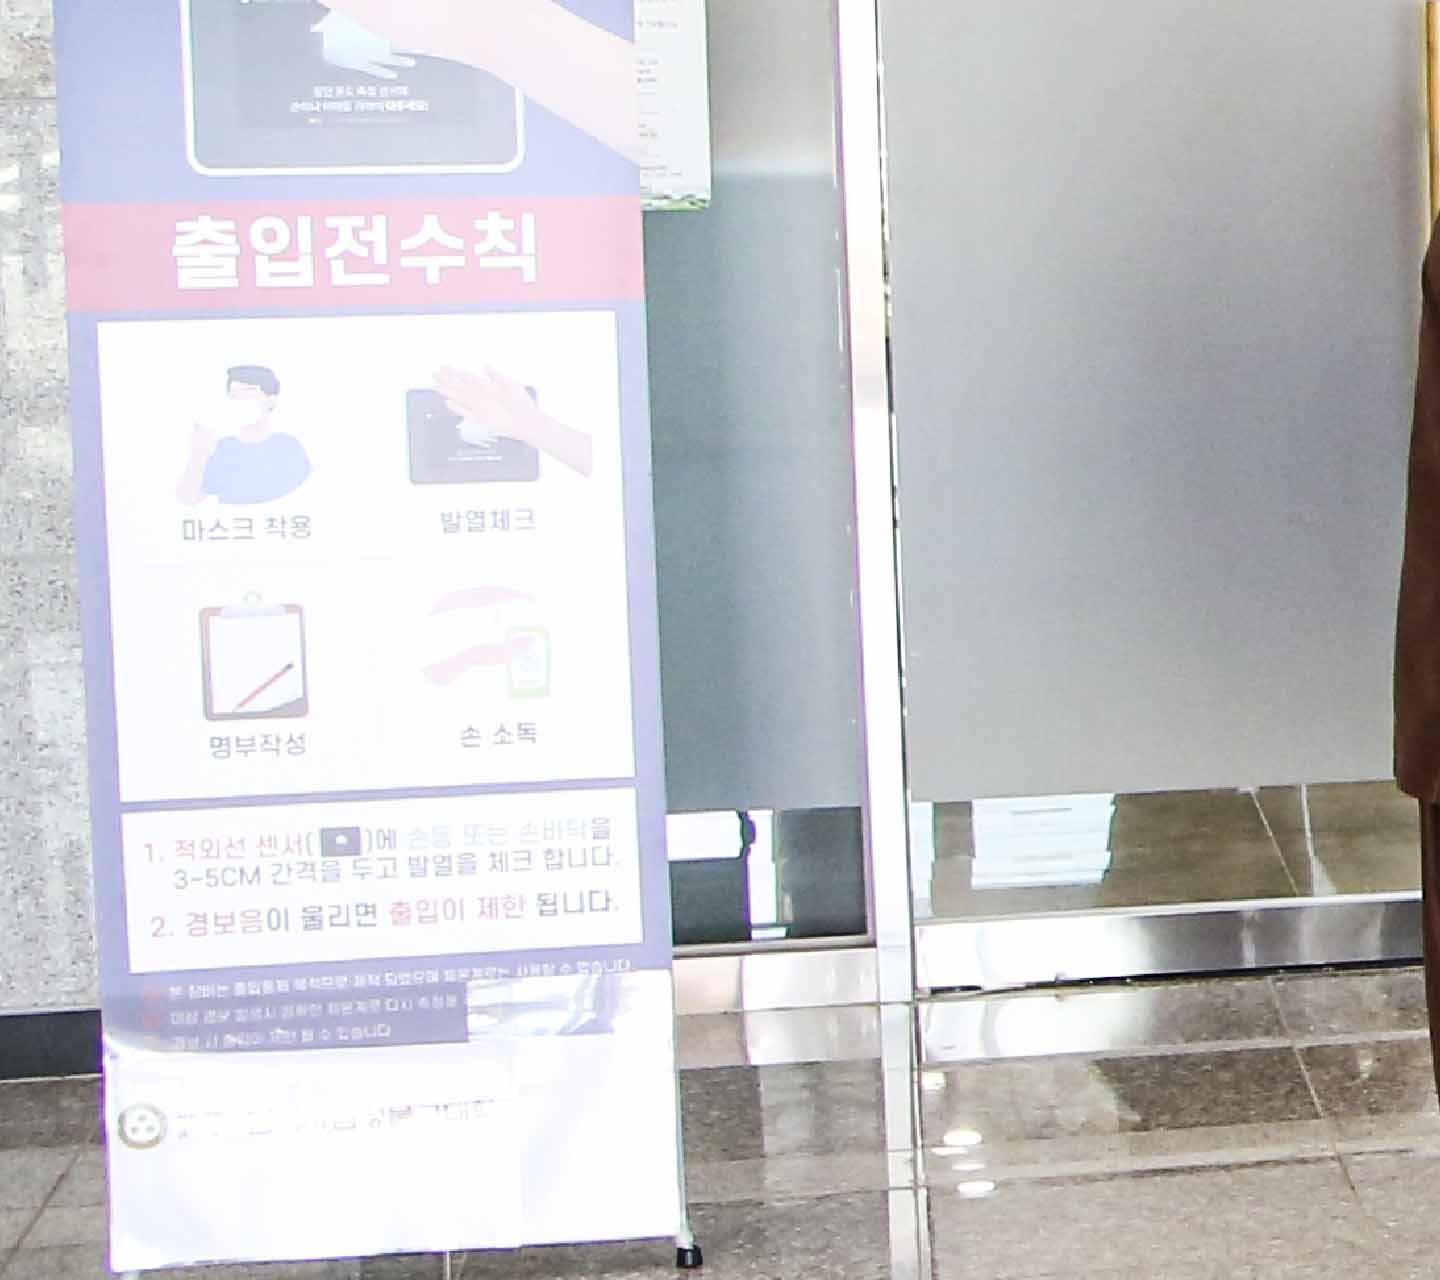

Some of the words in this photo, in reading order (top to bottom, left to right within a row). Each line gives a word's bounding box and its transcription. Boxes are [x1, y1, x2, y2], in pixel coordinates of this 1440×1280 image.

[171, 211, 537, 290] 출입전수칙
[182, 518, 255, 542] 마스크
[264, 515, 312, 540] 착용
[440, 508, 537, 534] 발열체크
[209, 732, 308, 760] 명부작성
[459, 724, 482, 748] 손
[492, 721, 538, 746] 소독
[144, 842, 165, 864] 1.
[175, 835, 247, 861] 적외선
[173, 866, 261, 890] 3-5CM
[271, 860, 342, 886] 간격을
[351, 857, 399, 880] 두고
[408, 852, 478, 878] 발열을
[488, 849, 534, 874] 체크
[543, 845, 621, 870] 합니다.
[151, 916, 175, 938] 2.
[186, 907, 290, 938] 경보음이
[300, 902, 378, 932] 울리면
[389, 897, 466, 928] 출입이
[476, 894, 528, 922] 제한
[535, 889, 621, 920] 됩니다.
